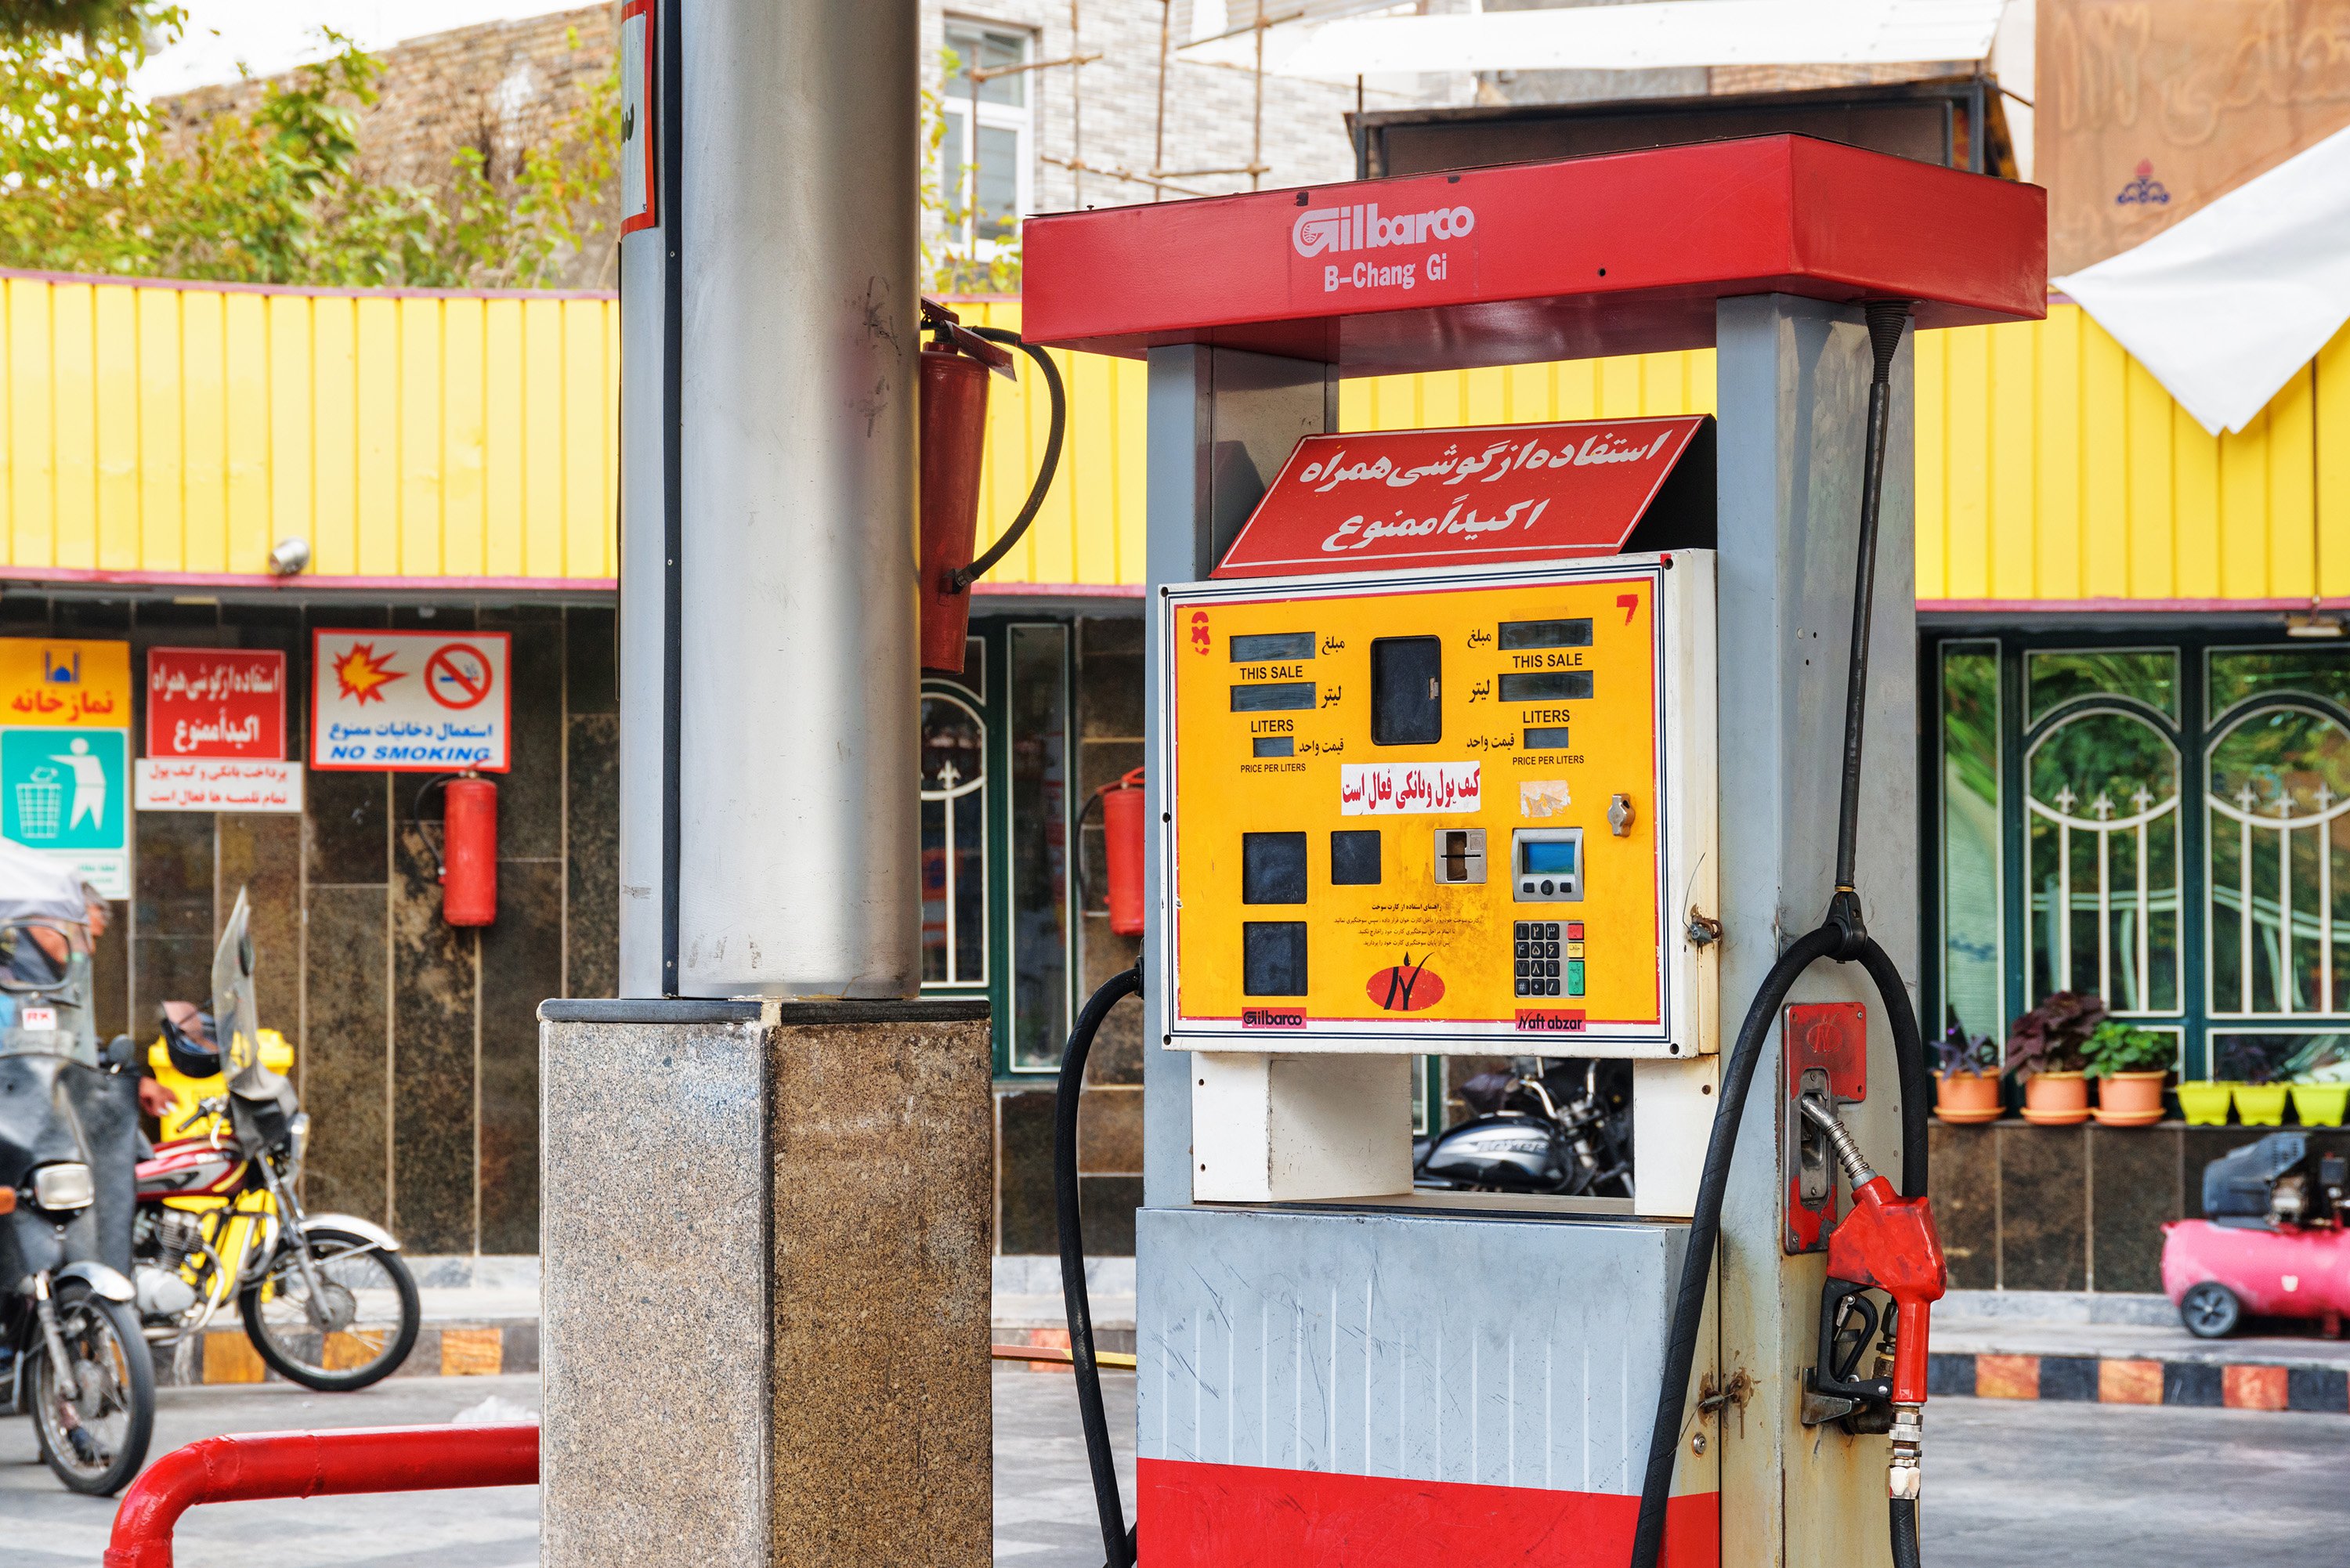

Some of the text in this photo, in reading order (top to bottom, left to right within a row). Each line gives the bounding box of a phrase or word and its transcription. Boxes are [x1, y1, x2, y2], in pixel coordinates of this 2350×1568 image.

[1292, 203, 1475, 258] Gilbarco
[1325, 252, 1447, 292] B-Chang Gi
[1321, 510, 1438, 551] ممنوع
[1321, 636, 1345, 655] مبلغ
[1467, 629, 1491, 649] مبلغ
[1513, 653, 1582, 668] THIS SALE
[1240, 666, 1303, 680] THIS SALE
[1321, 685, 1342, 709] لیتر
[1469, 679, 1490, 703] لیتر
[11, 688, 114, 722] نماز خانه
[1523, 709, 1571, 724] LITERS
[329, 722, 493, 741] استعمال دخانیات ممنوع
[1251, 719, 1294, 733] LITERS
[1299, 738, 1344, 756] قیمت واحد
[1466, 733, 1514, 751] قیمت واحد
[331, 746, 490, 761] NO SMOKING
[1513, 755, 1585, 765] PRICE PER LITERS
[1240, 763, 1306, 773] PRICE PER LITERS
[1342, 772, 1365, 803] است
[1368, 768, 1392, 810] فعال
[1387, 903, 1400, 912] کارت
[1423, 903, 1441, 912] راهنمای
[1243, 1010, 1302, 1026] Gilbarco
[1548, 1015, 1582, 1030] abzar
